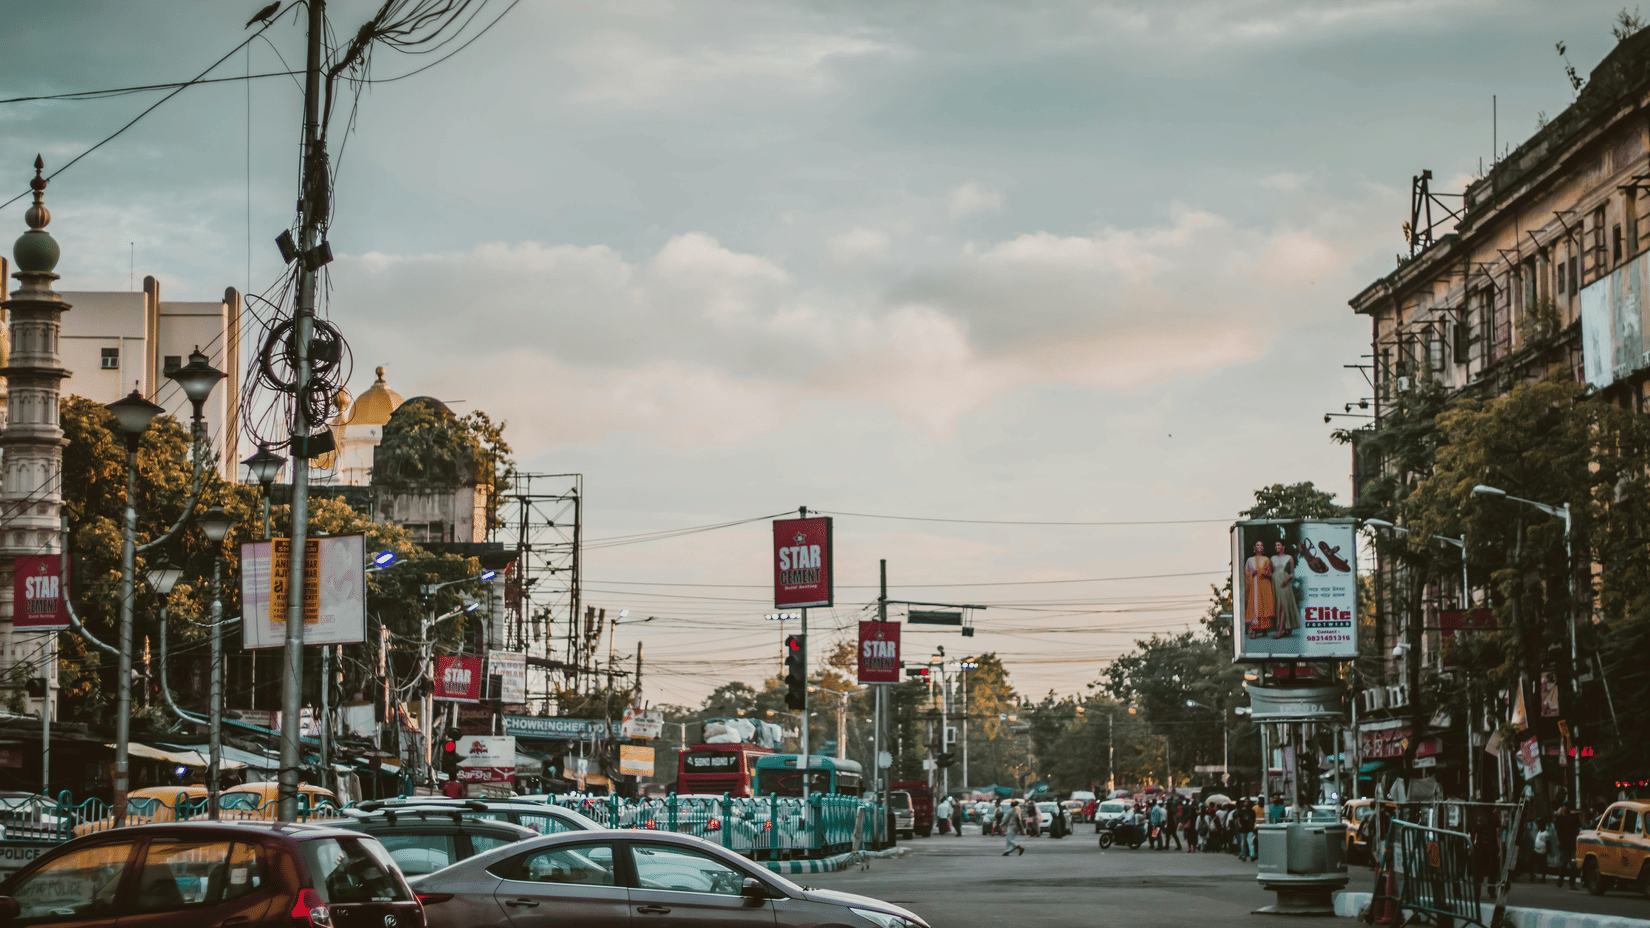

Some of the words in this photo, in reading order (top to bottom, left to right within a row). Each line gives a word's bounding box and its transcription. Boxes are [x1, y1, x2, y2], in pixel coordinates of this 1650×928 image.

[779, 545, 821, 570] STAR
[780, 568, 821, 585] CEMENT
[25, 575, 59, 599] STAR
[25, 599, 58, 613] CEMENT
[1305, 606, 1351, 620] Elite
[863, 641, 896, 658] STAR
[863, 657, 895, 669] CEMENT
[444, 667, 472, 684] STAR
[0, 849, 40, 860] POLICE
